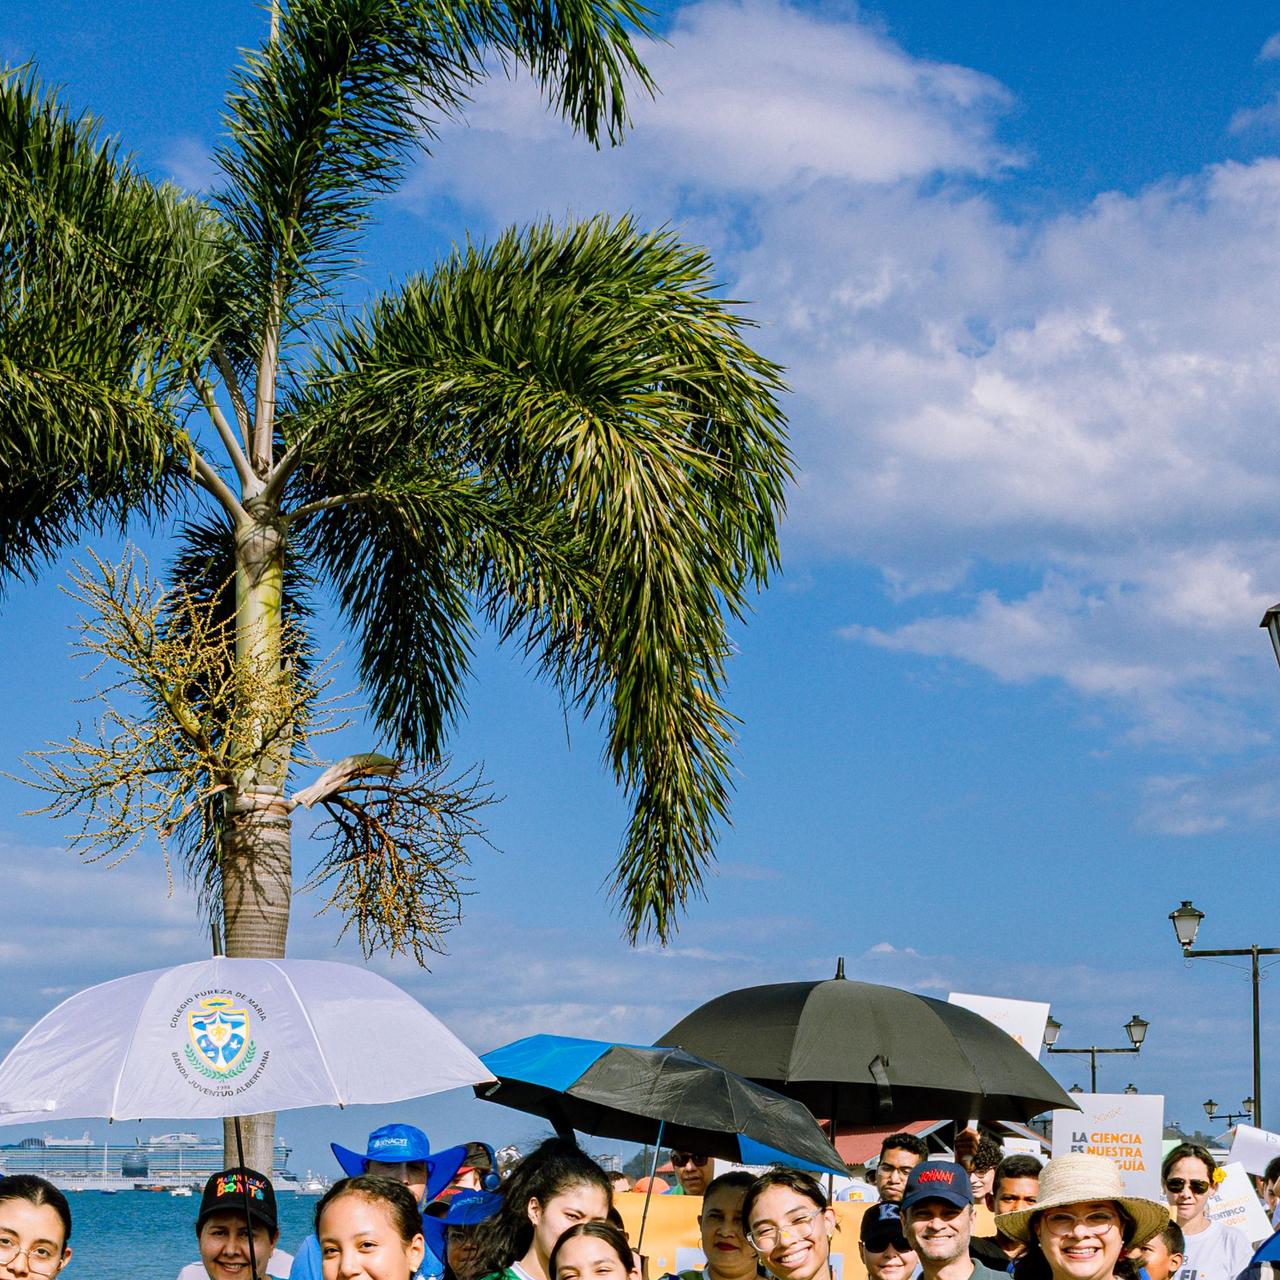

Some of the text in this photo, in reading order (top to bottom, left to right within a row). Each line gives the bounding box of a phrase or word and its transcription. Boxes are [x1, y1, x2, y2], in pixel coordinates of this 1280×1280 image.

[170, 997, 194, 1028] COLEGIO
[194, 989, 233, 999] PUREZA
[235, 992, 247, 1000] DE
[171, 1050, 270, 1097] BANDA JUVENTUD ALBERTIANA
[1072, 1132, 1142, 1144] LA CIENCIA
[1087, 1146, 1143, 1158] NUESTRA
